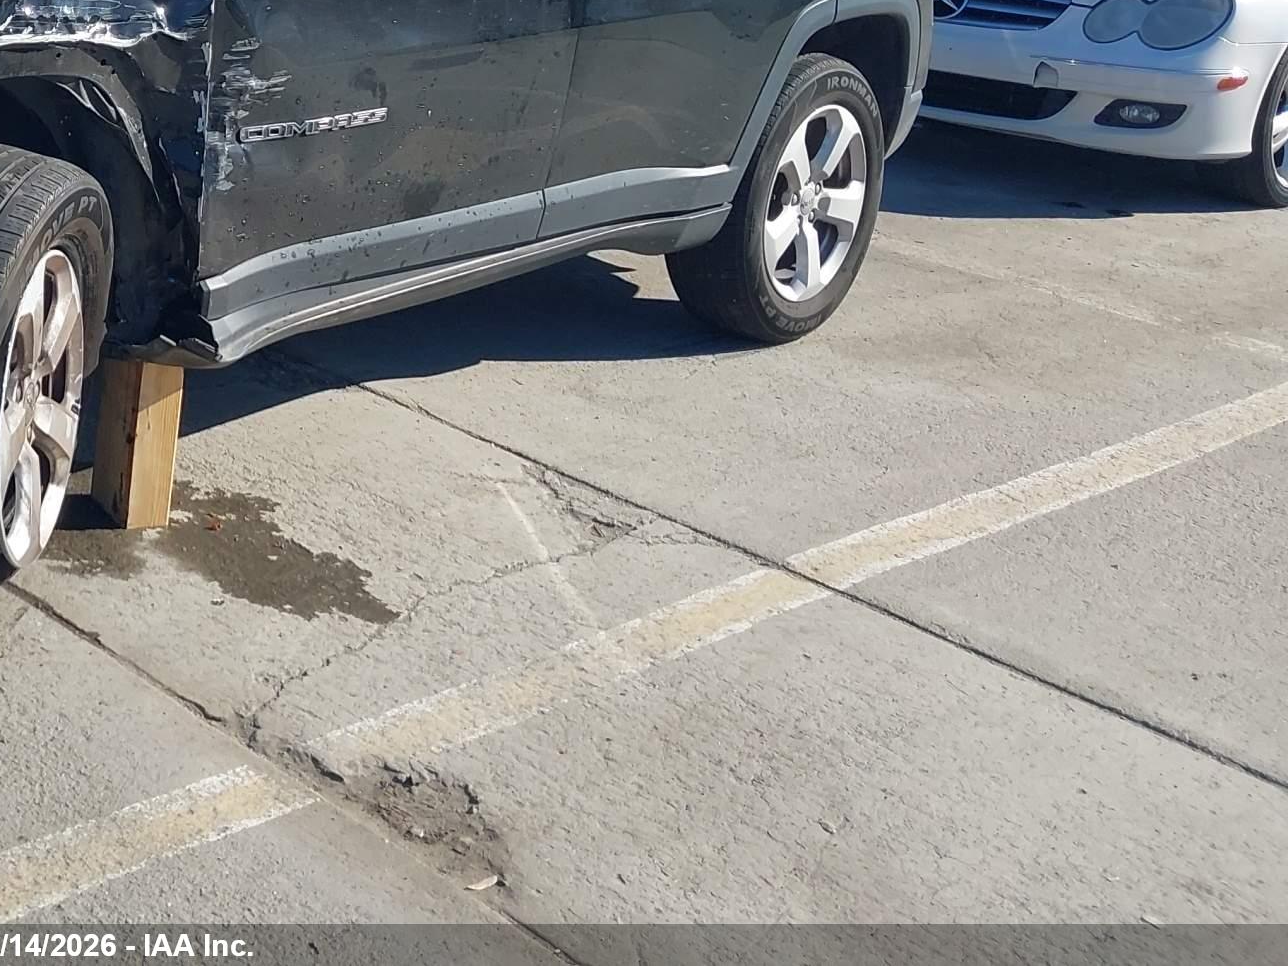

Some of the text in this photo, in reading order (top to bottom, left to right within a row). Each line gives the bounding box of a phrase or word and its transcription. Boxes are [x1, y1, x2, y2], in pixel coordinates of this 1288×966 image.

[827, 76, 878, 117] IRONMAN
[238, 107, 389, 143] COMPASS
[78, 196, 97, 214] PT
